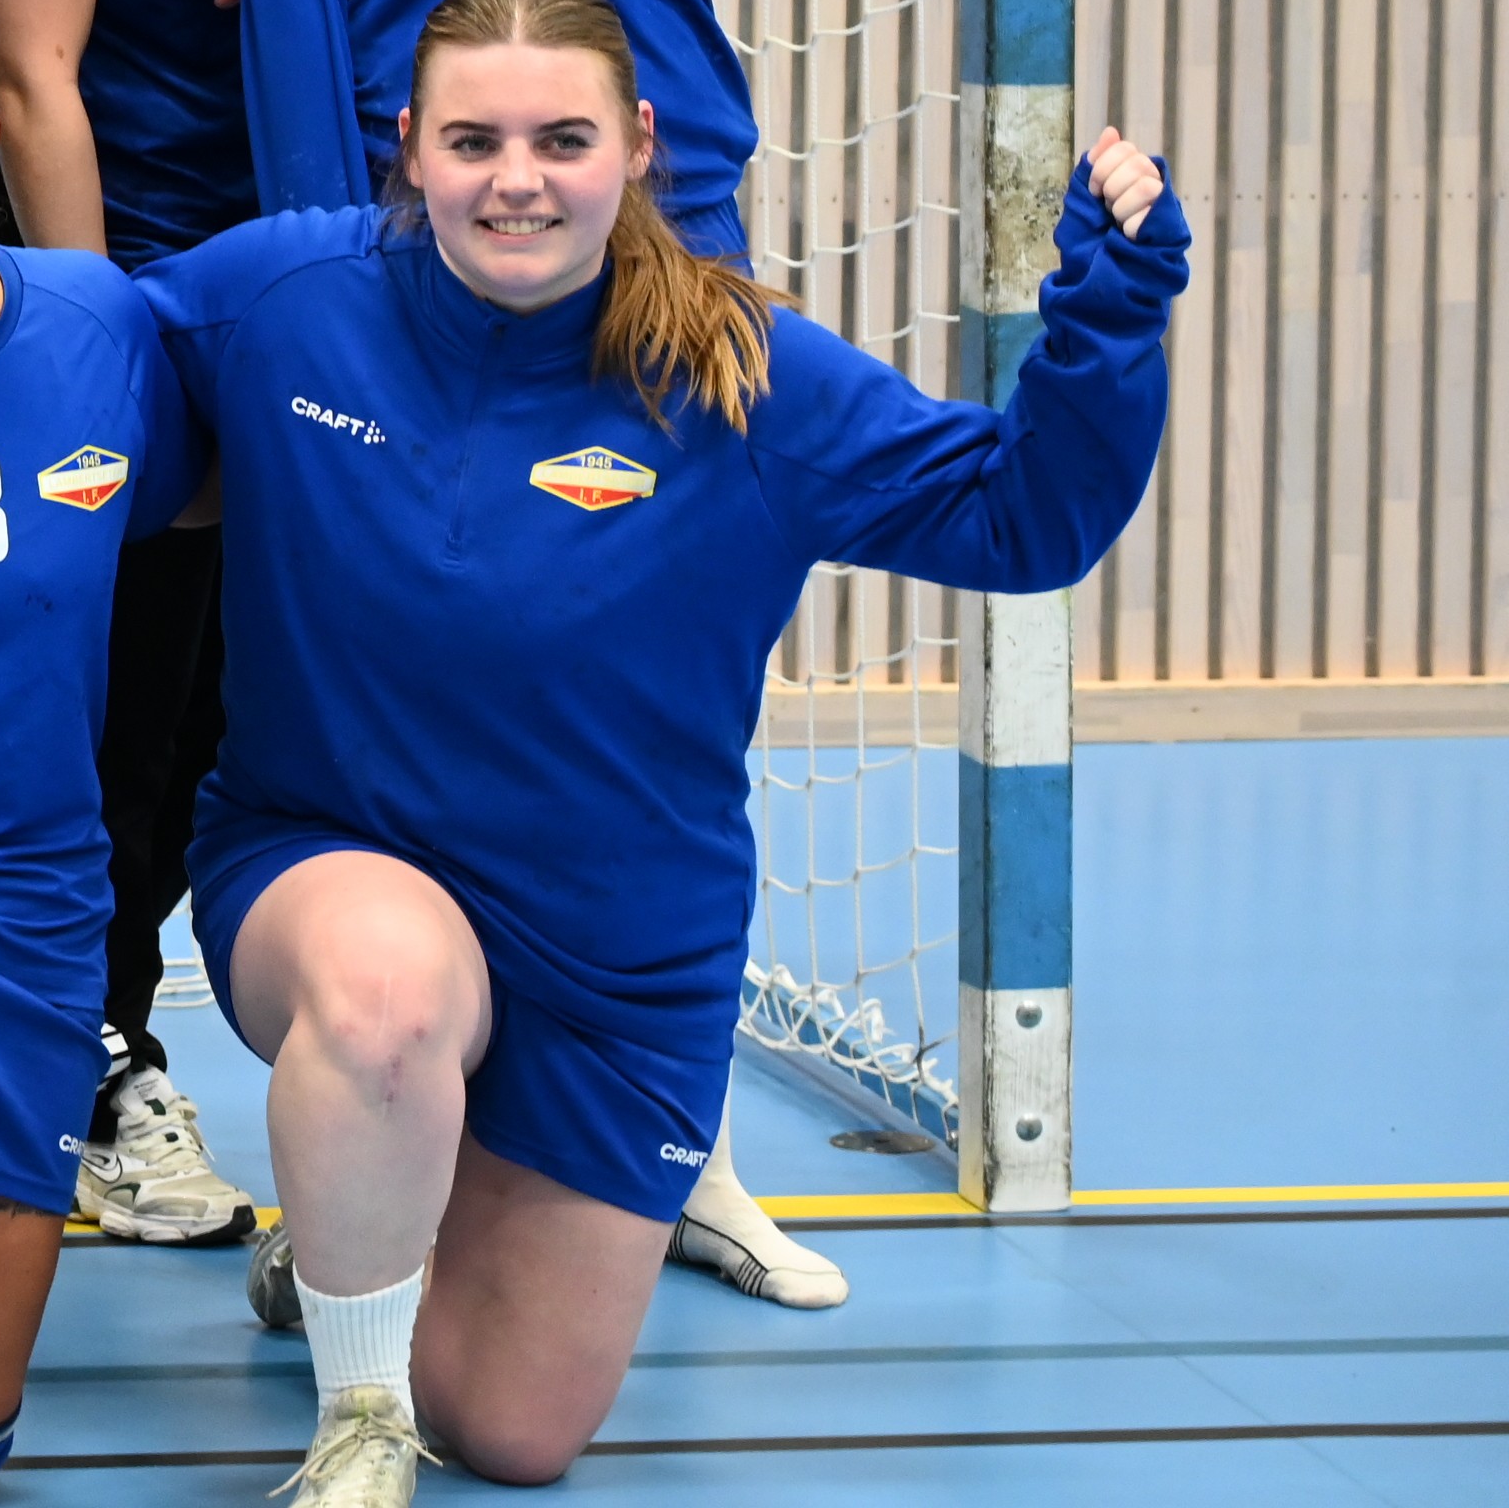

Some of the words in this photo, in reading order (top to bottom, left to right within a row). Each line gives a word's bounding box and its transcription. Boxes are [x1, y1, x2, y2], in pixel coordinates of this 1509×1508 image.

[291, 396, 363, 436] CRAFT
[76, 453, 102, 470] 1945
[581, 454, 613, 469] 1945
[660, 1142, 707, 1168] CRAFT
